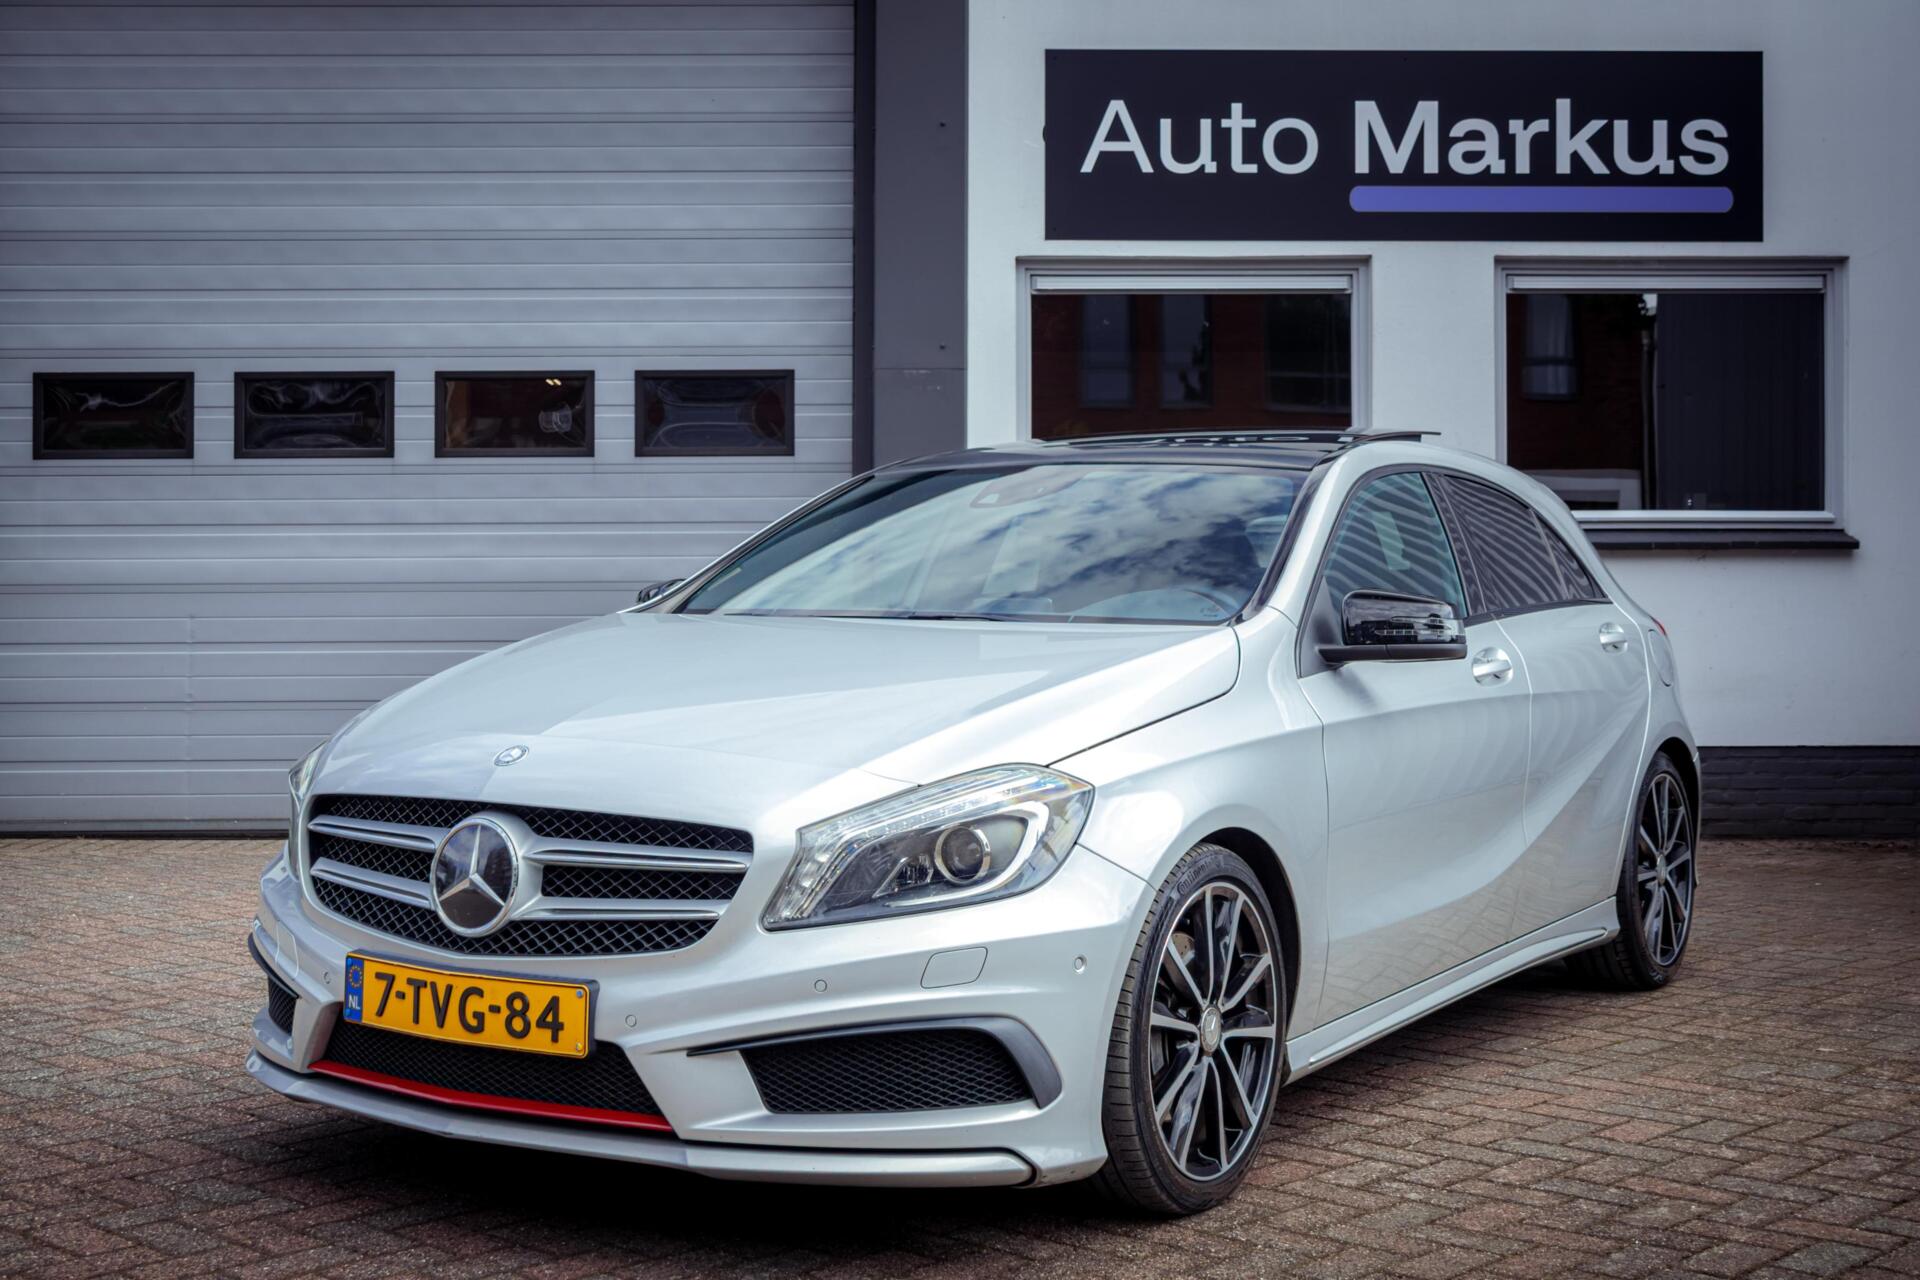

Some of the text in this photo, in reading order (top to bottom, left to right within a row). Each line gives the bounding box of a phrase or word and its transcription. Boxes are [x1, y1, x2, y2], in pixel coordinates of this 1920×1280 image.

[1079, 98, 1730, 176] Auto Markus
[348, 994, 361, 1010] NL
[374, 971, 565, 1044] 7-TVG-84
